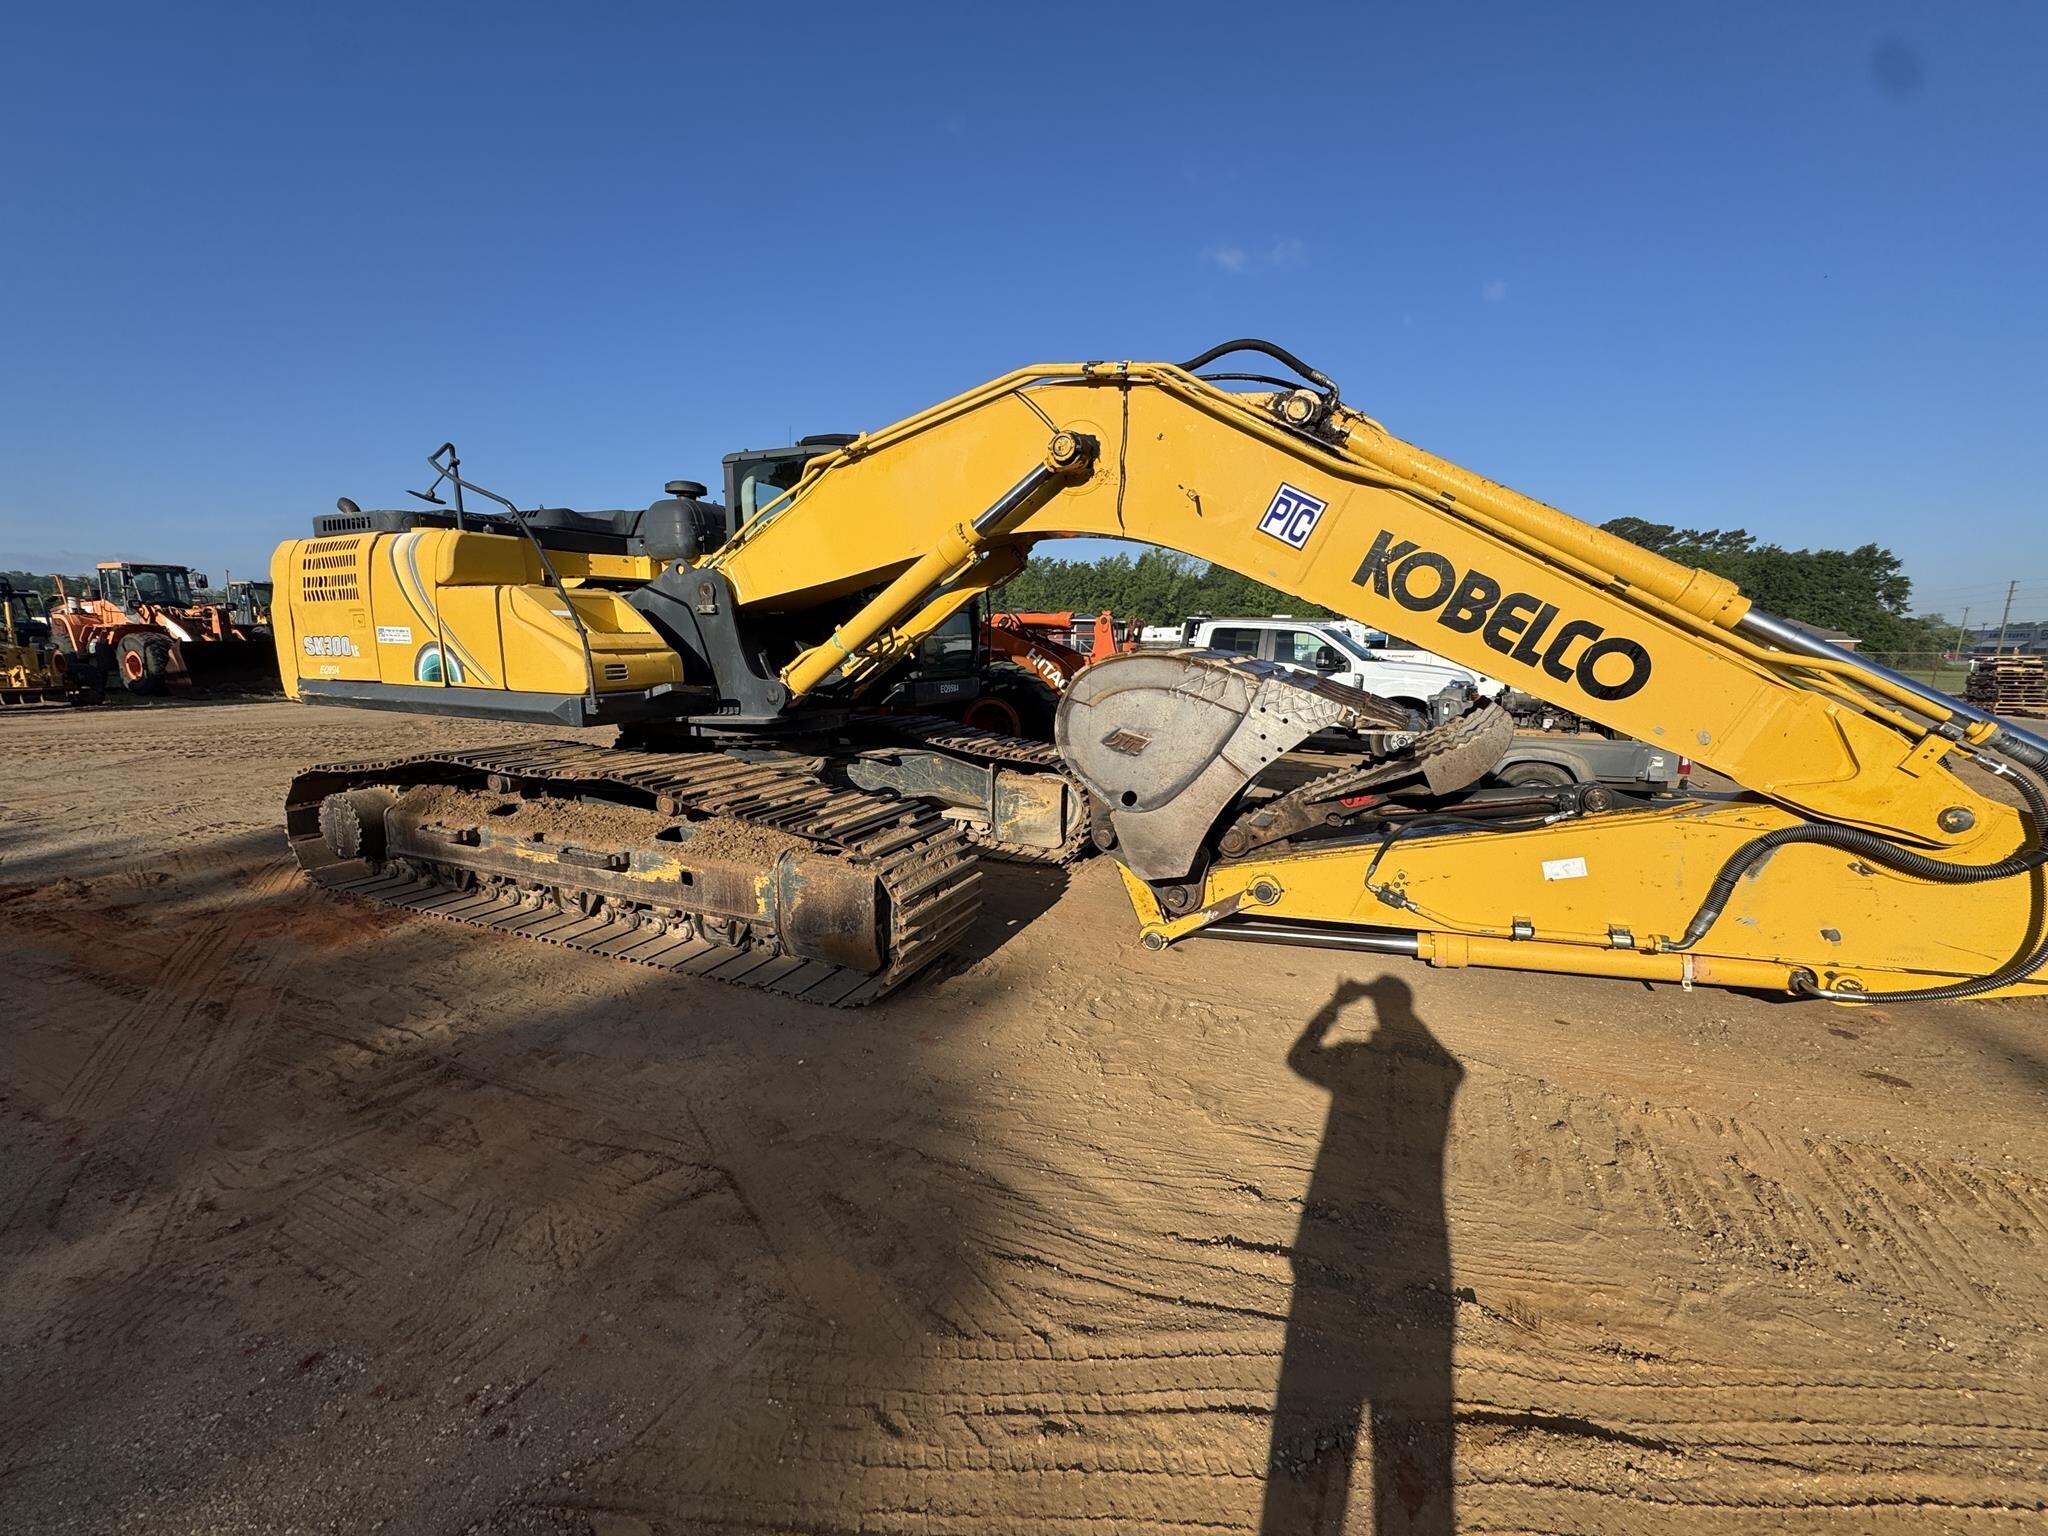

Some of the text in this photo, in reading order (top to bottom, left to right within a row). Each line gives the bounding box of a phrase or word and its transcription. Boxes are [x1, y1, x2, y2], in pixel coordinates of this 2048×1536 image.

[1263, 488, 1322, 543] PTC
[1351, 529, 1652, 701] KOBELCO
[303, 635, 352, 656] SK300
